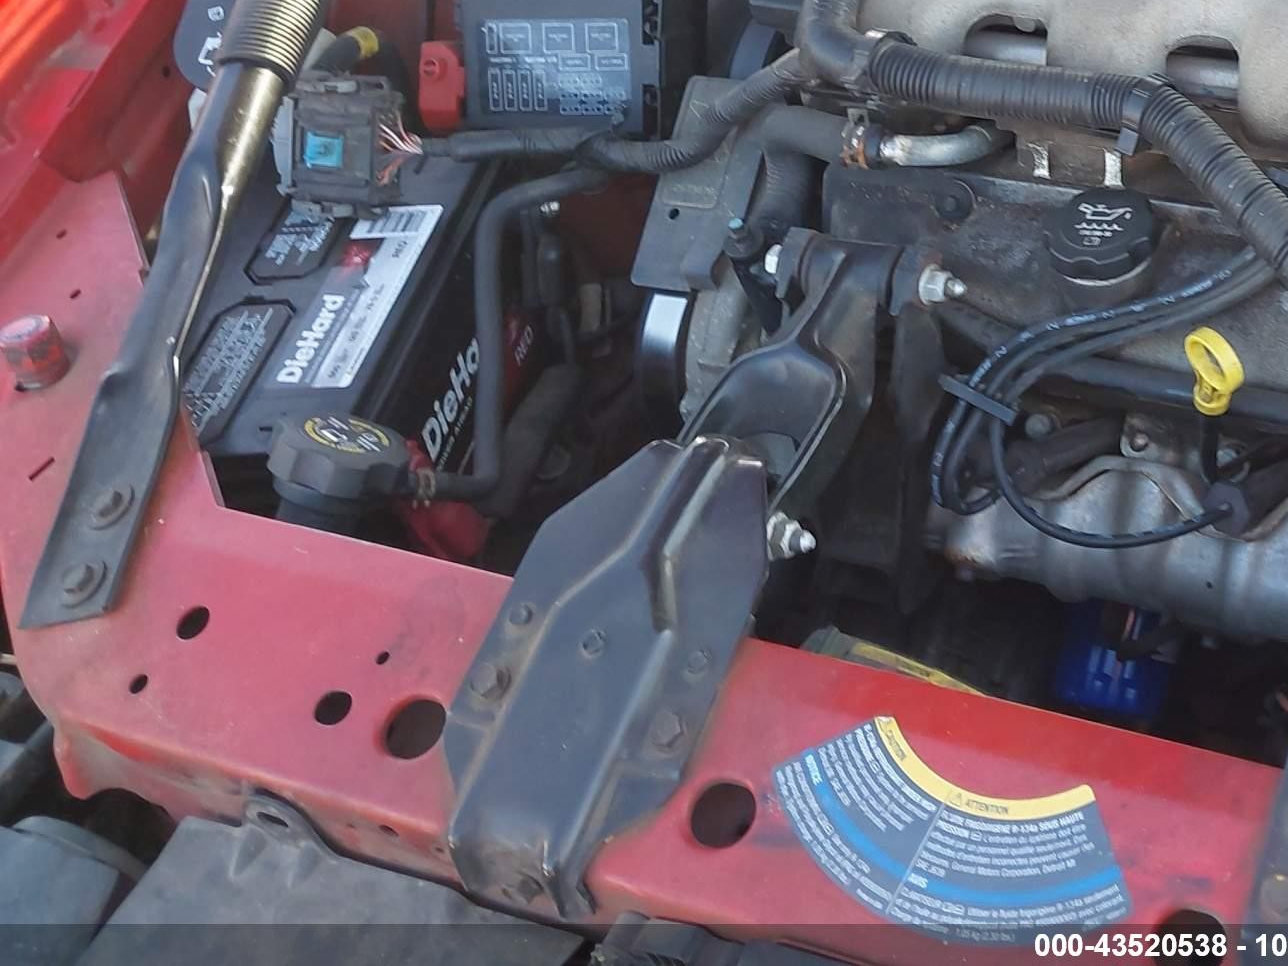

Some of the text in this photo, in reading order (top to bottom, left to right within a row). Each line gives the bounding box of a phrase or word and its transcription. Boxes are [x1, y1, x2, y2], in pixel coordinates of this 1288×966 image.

[275, 294, 346, 384] DieHard
[421, 337, 480, 463] DieHa
[965, 798, 1009, 815] ATTENTION
